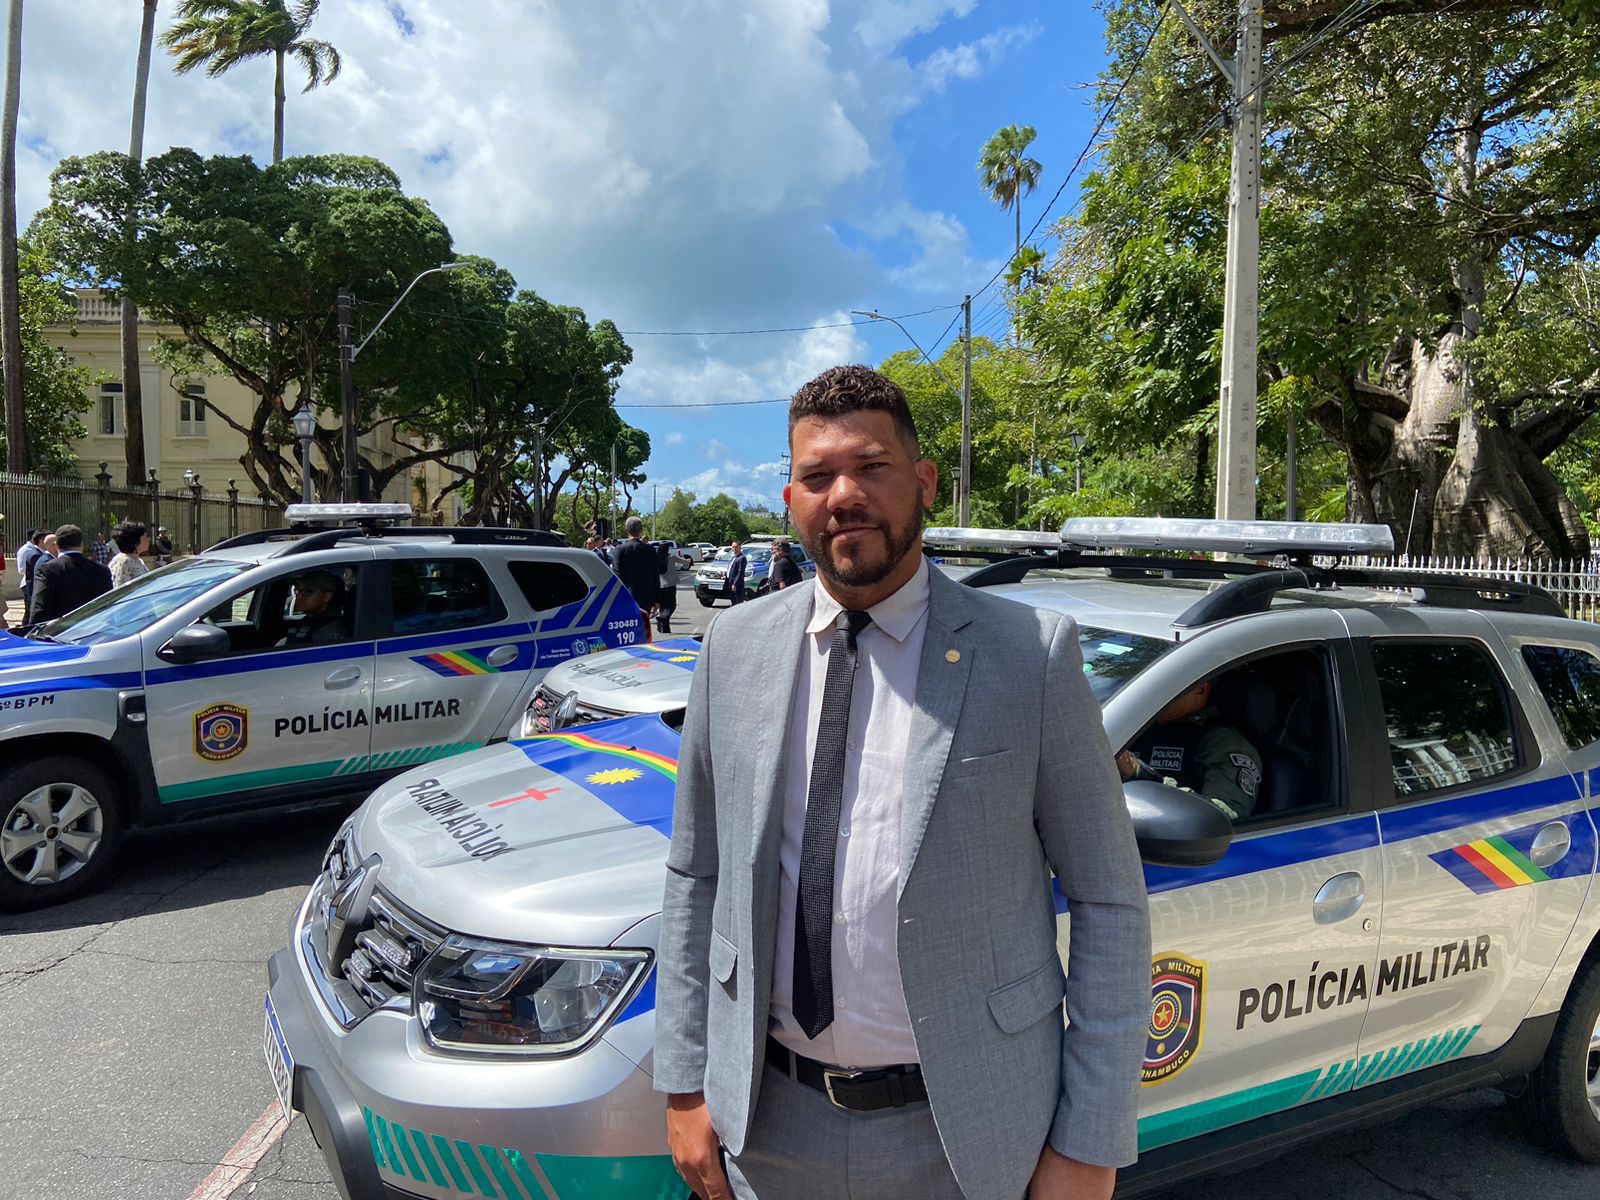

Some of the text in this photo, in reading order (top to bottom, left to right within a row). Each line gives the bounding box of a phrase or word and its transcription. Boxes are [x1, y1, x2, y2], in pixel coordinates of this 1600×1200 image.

[608, 619, 639, 630] 330481
[617, 631, 635, 645] 190
[13, 694, 55, 709] BPM
[274, 698, 461, 738] POLÍCIA MILITAR
[1151, 759, 1179, 768] MILITAR
[1168, 961, 1201, 978] MILITAR
[1235, 934, 1491, 1031] POLÍCIA MILITAR
